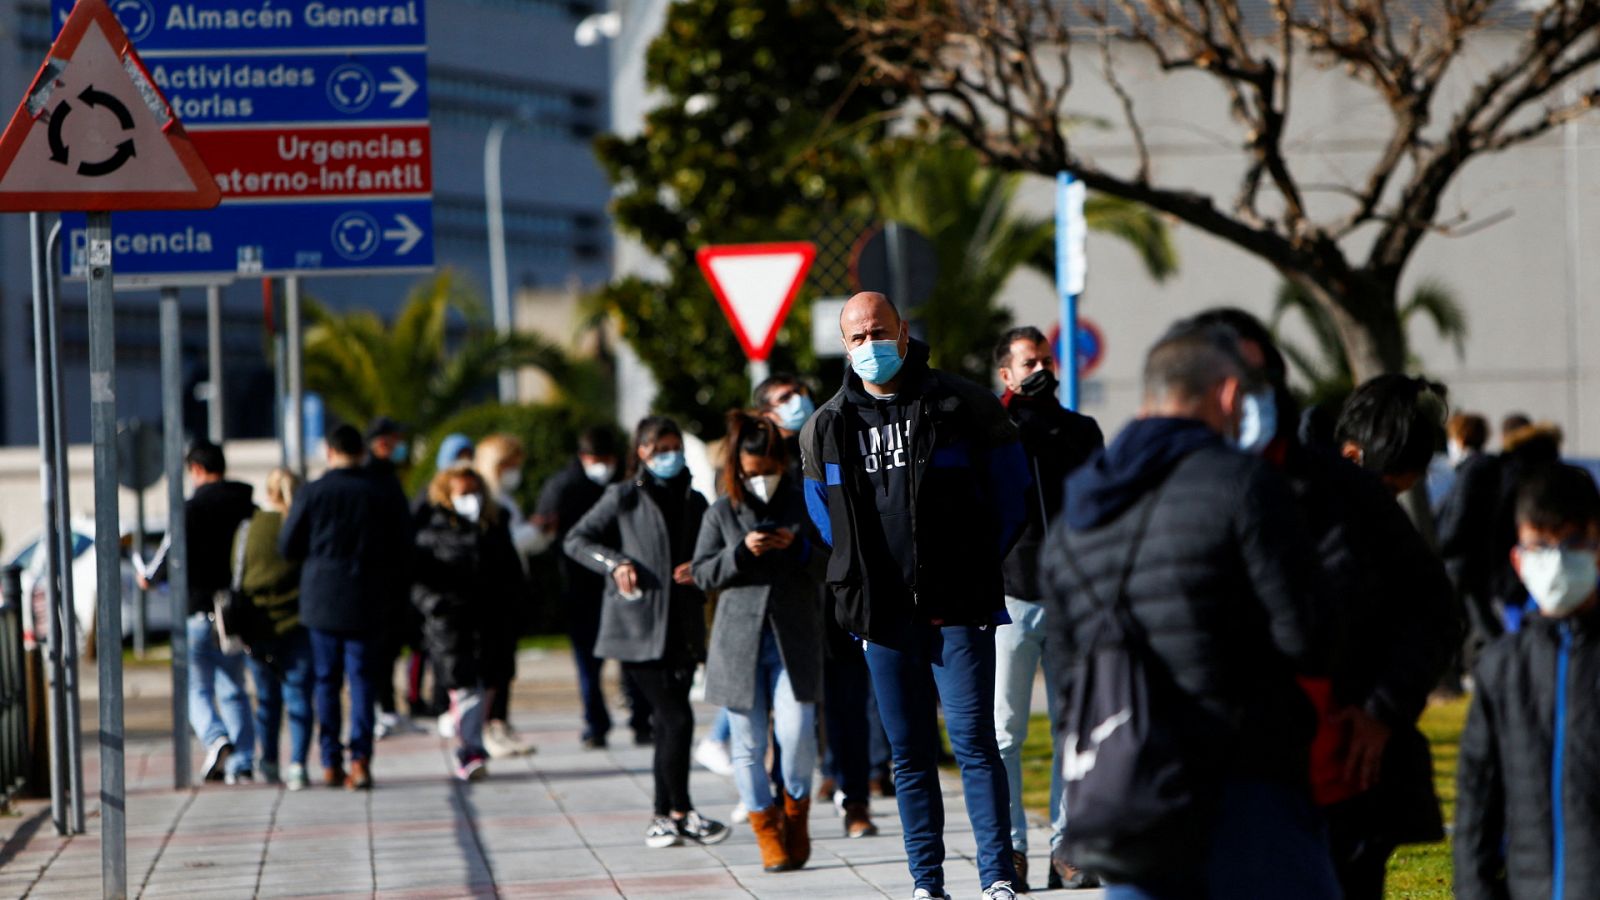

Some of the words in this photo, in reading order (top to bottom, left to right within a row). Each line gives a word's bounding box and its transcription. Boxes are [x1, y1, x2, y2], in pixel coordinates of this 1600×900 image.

[166, 1, 292, 29] Almacén
[304, 1, 418, 27] General
[153, 64, 315, 88] Actividades
[172, 94, 253, 118] torias
[278, 134, 422, 164] Urgencias
[214, 164, 423, 192] aterno-Infantil
[71, 227, 212, 254] Dcencia
